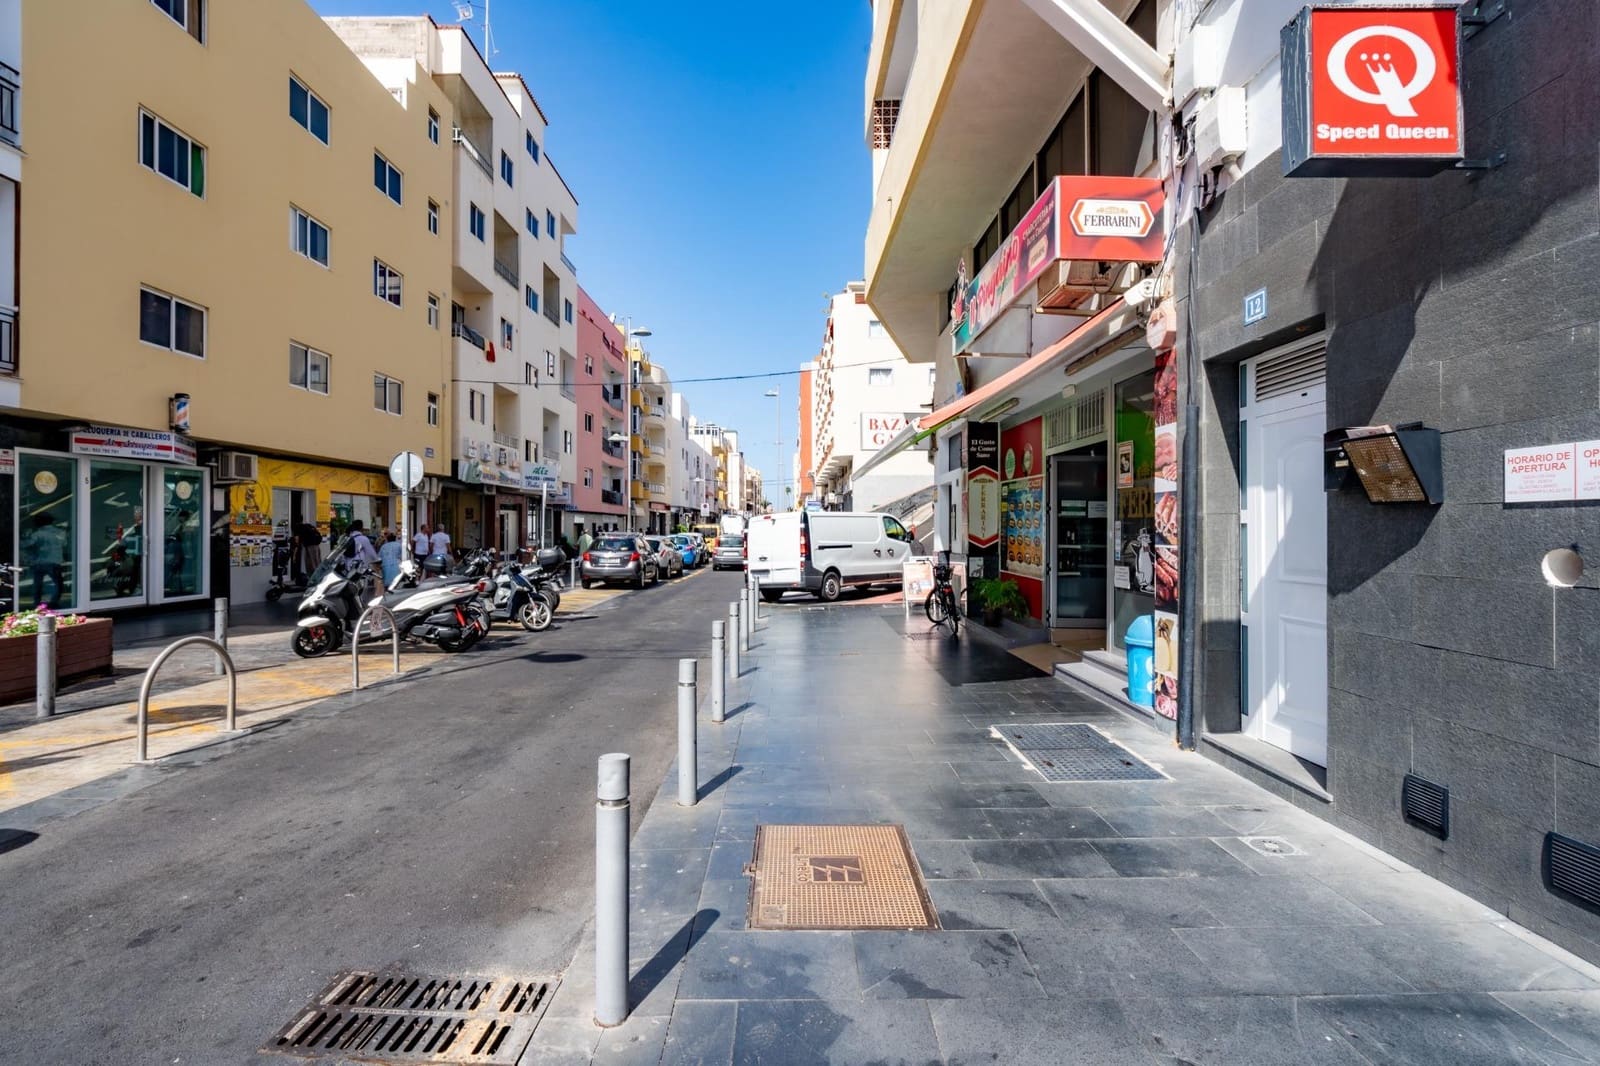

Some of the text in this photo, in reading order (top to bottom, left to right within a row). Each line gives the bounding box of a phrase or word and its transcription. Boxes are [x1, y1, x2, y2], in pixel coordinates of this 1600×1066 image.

[1316, 123, 1449, 143] Speed Queen
[1083, 214, 1141, 228] FERRARINI
[1249, 297, 1262, 316] 12
[131, 430, 171, 442] CABALLEROS
[1507, 451, 1571, 465] HORARIO DE
[1511, 462, 1567, 474] APERTURA
